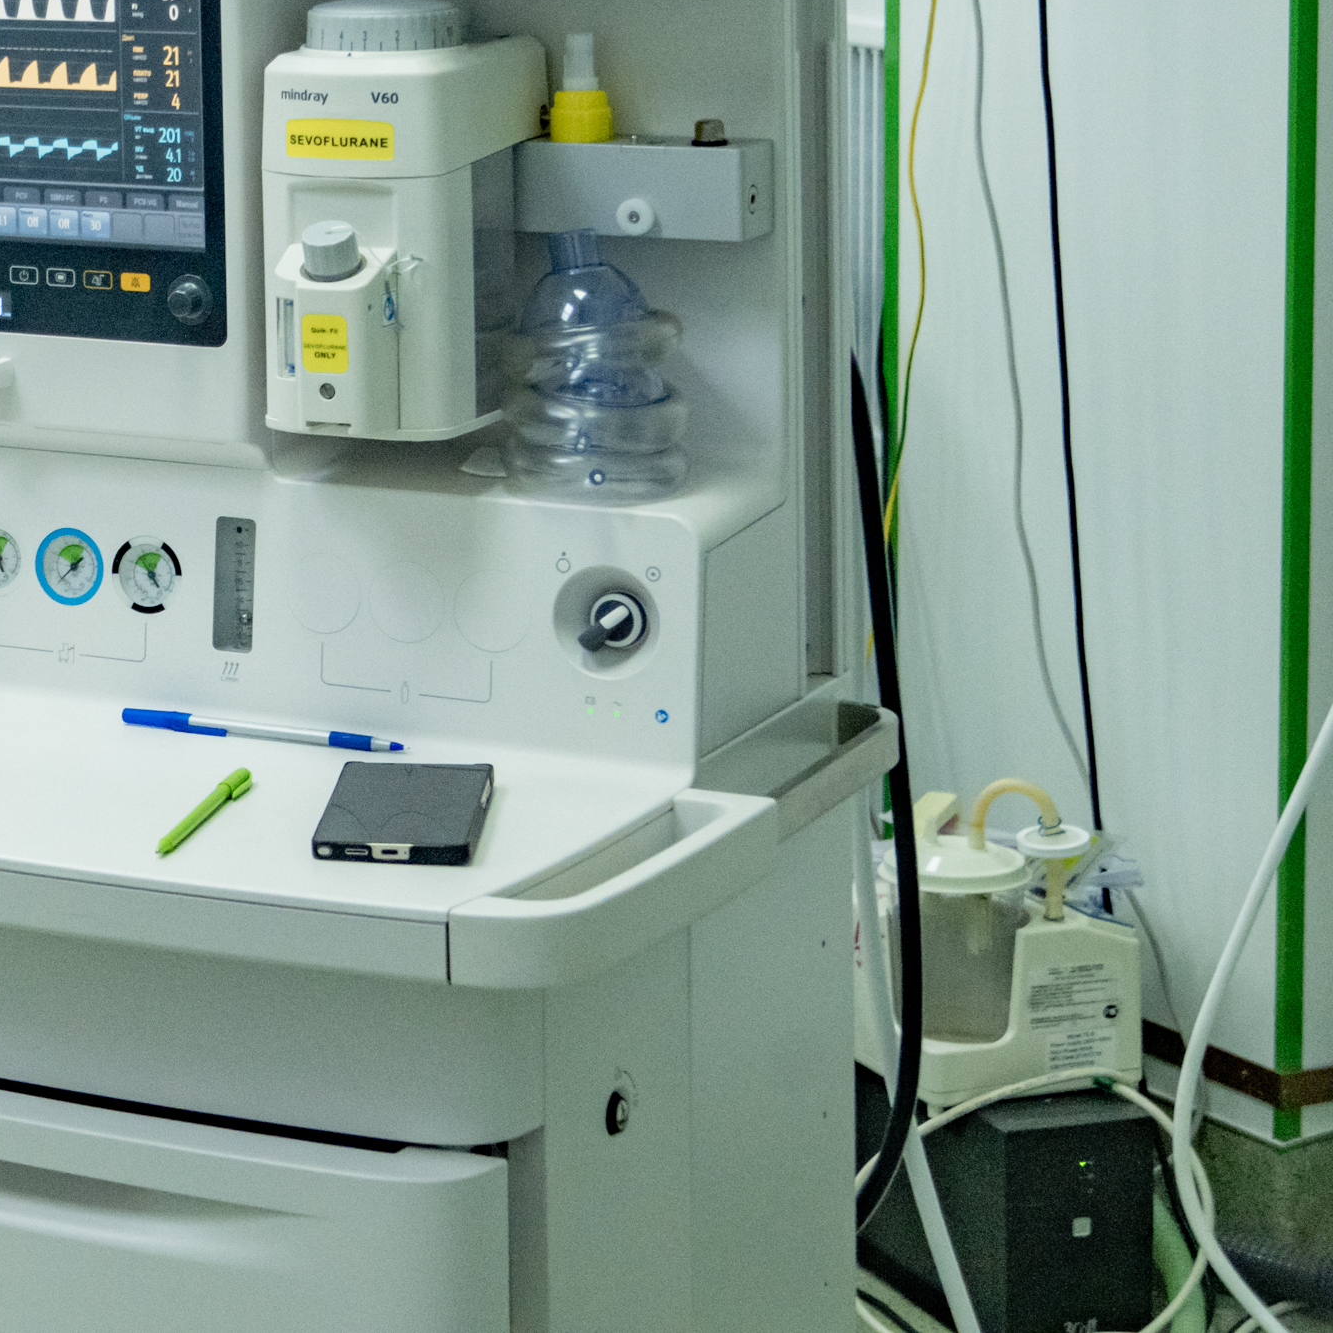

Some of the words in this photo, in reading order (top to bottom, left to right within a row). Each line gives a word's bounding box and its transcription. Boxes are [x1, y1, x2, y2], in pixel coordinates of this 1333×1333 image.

[169, 4, 179, 21] 0
[162, 45, 180, 66] 21
[165, 69, 180, 87] 21
[171, 93, 181, 110] 4
[281, 89, 329, 105] mindray
[370, 91, 399, 104] V60
[158, 127, 181, 144] 201
[290, 134, 389, 148] SEVOFLURANE
[165, 147, 182, 163] 4.1
[166, 167, 182, 182] 20
[15, 191, 28, 200] PCV
[175, 200, 198, 209] Manual
[27, 216, 39, 228] Off
[58, 218, 70, 229] Off
[90, 220, 101, 231] 30
[314, 351, 336, 359] ONLY
